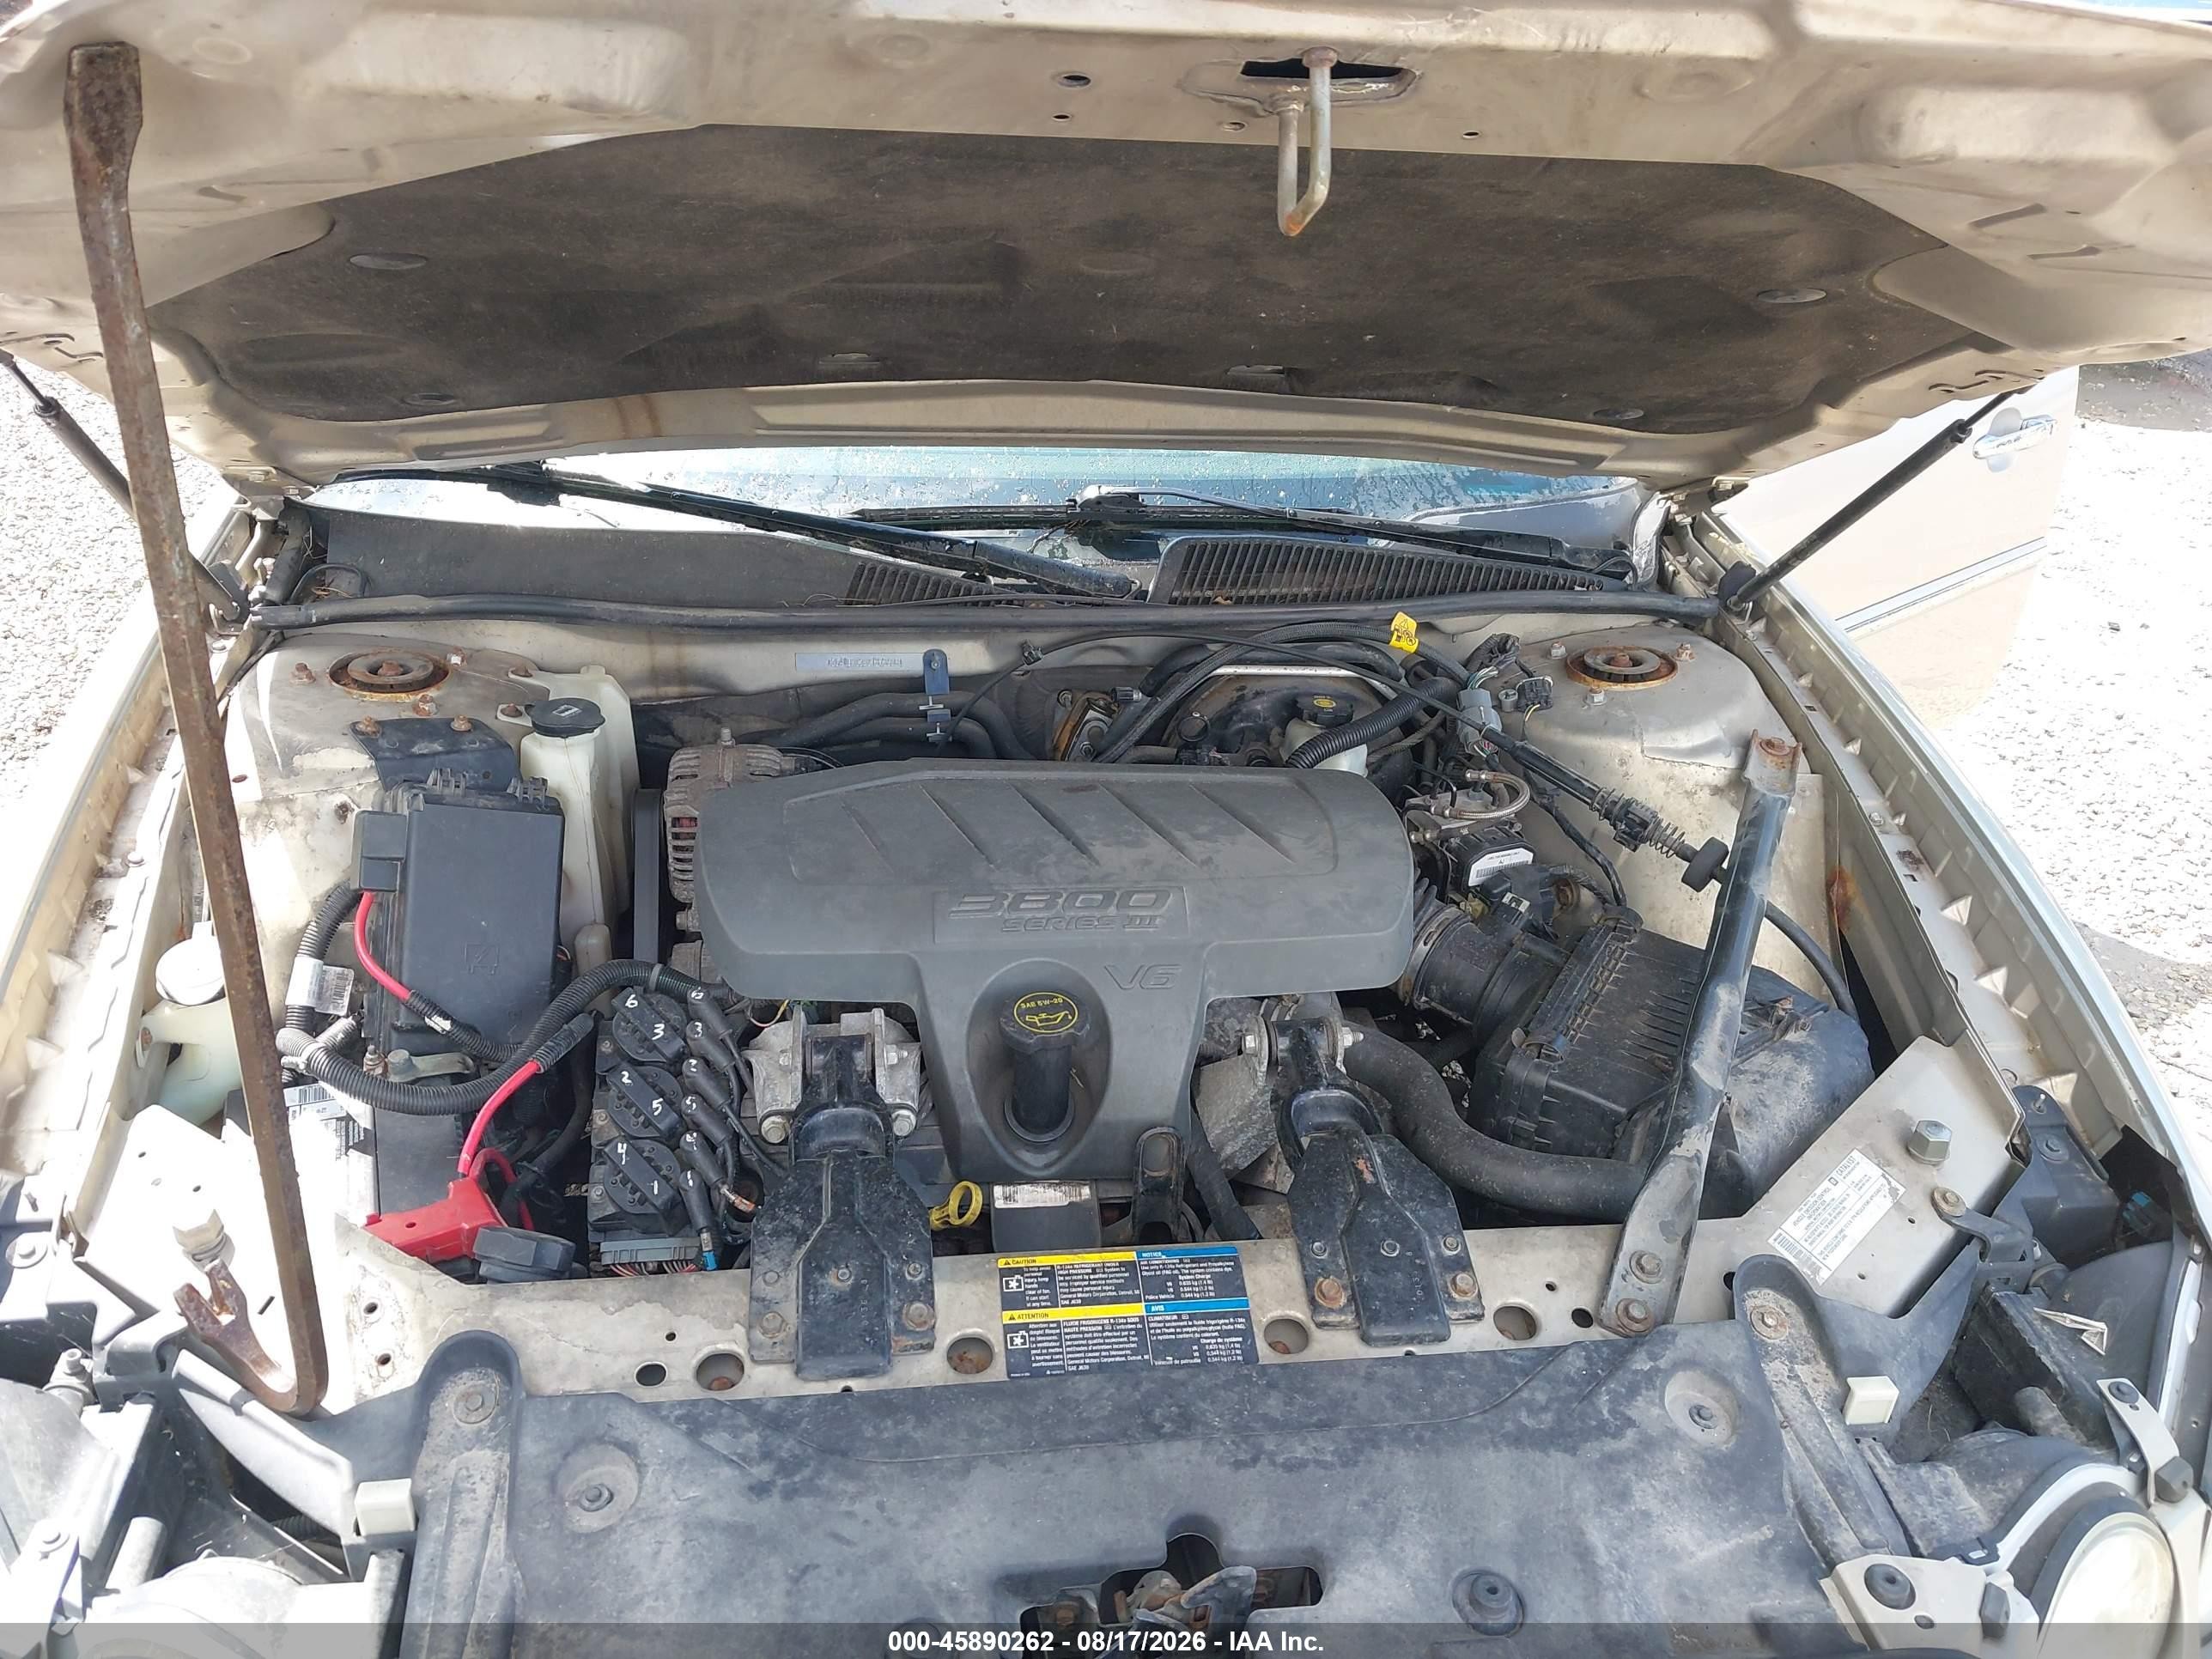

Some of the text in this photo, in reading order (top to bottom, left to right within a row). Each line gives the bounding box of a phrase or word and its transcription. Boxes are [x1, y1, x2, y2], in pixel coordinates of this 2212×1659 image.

[948, 890, 1171, 917] 3800
[1001, 915, 1118, 933] SERIES
[1103, 963, 1182, 990] V6
[625, 994, 638, 1008] 6
[652, 1024, 665, 1040] 3
[621, 1071, 634, 1084] 2
[652, 1097, 664, 1116] 5
[617, 1142, 627, 1165] 4
[1835, 1155, 1856, 1176] CATALYST
